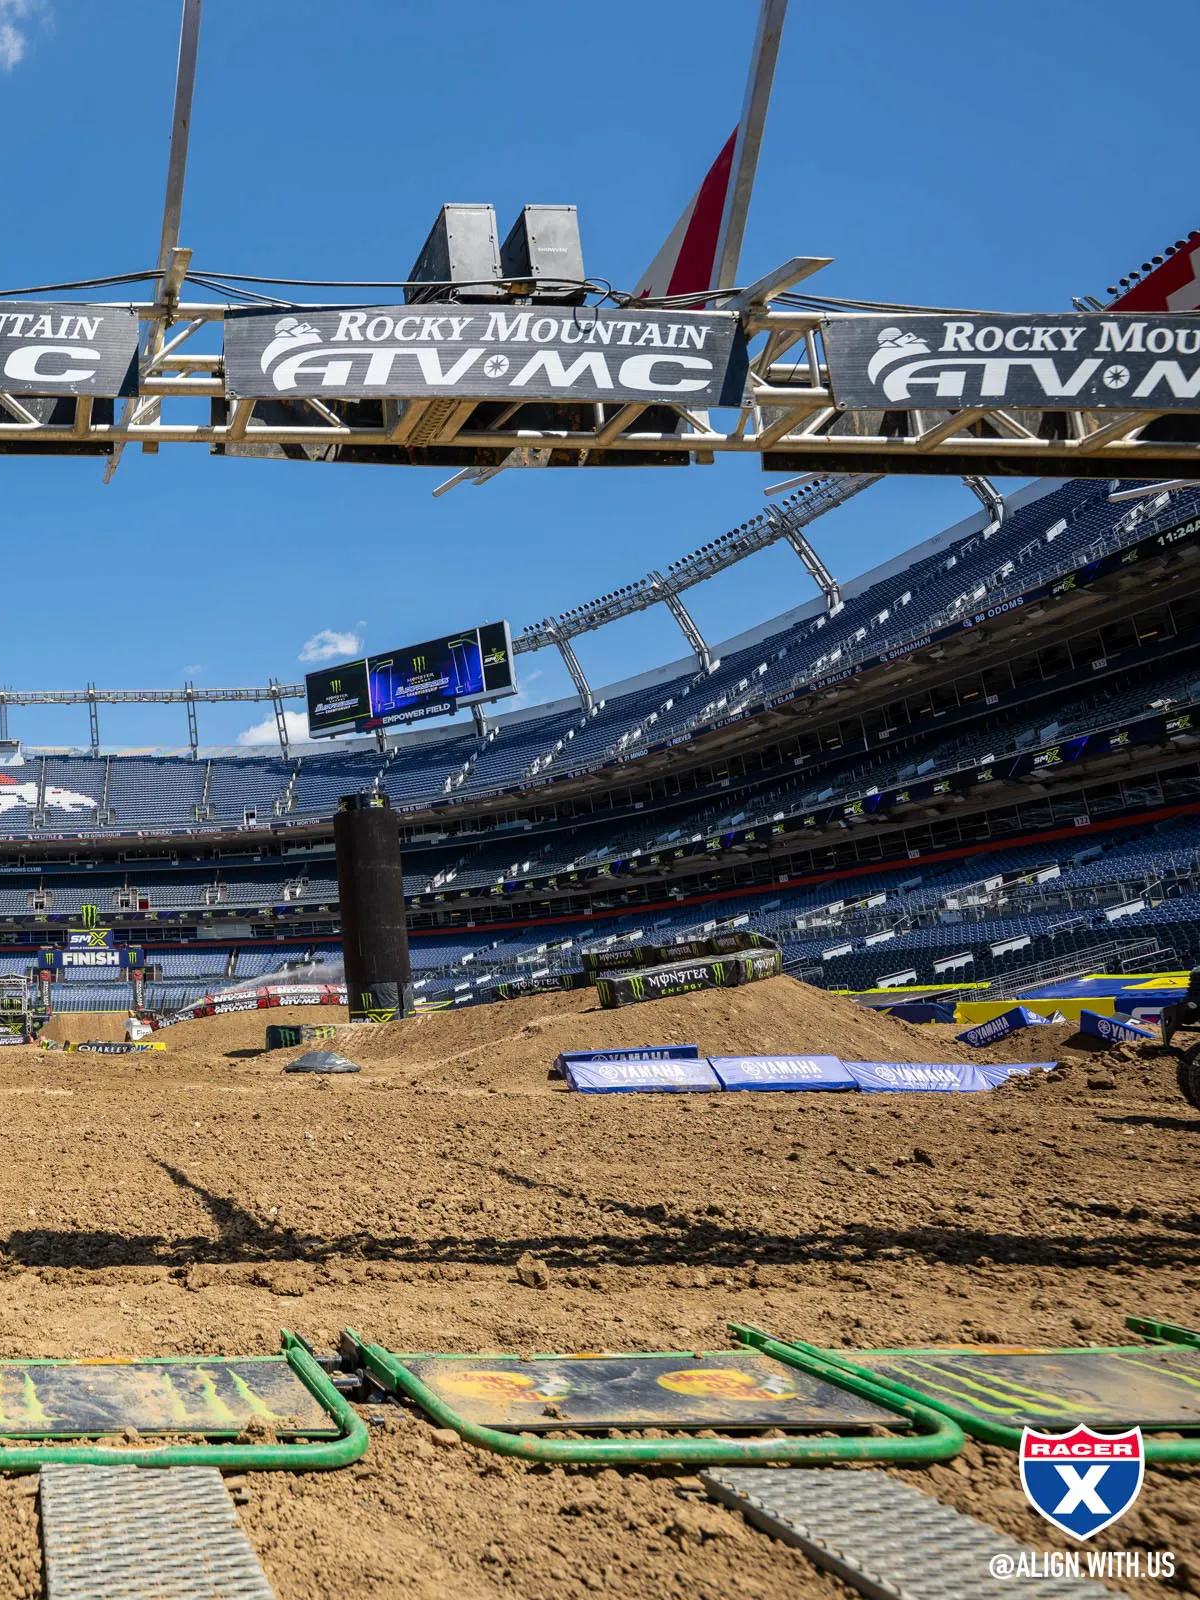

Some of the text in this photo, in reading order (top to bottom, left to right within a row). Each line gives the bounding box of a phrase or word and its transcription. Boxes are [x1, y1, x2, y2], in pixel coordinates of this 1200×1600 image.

[330, 311, 711, 349] ROCKY MOUNTAIN
[942, 321, 1087, 353] ROCKY
[974, 597, 1025, 623] 88 ODOMS
[888, 636, 932, 659] SHANAHAN
[817, 670, 851, 689] 24 BAILEY
[777, 693, 795, 704] ELAM
[382, 703, 451, 724] EMPOWER FIELD
[724, 713, 743, 726] LYNCH
[1166, 716, 1192, 729] SMX
[672, 733, 692, 745] REEVES
[630, 750, 648, 761] MINGO
[1034, 750, 1061, 764] SMX
[70, 932, 109, 947] SMX
[62, 952, 120, 966] FINISH
[599, 950, 633, 961] MONSTER
[512, 977, 561, 990] MONSTER
[648, 967, 709, 988] MONSTER
[661, 982, 703, 995] ENERGY
[976, 1016, 1010, 1040] YAMAHA
[90, 1045, 128, 1054] OAKLEY
[615, 1066, 685, 1079] YAMAHA
[757, 1062, 822, 1075] YAMAHA
[895, 1069, 962, 1083] YAMAHA
